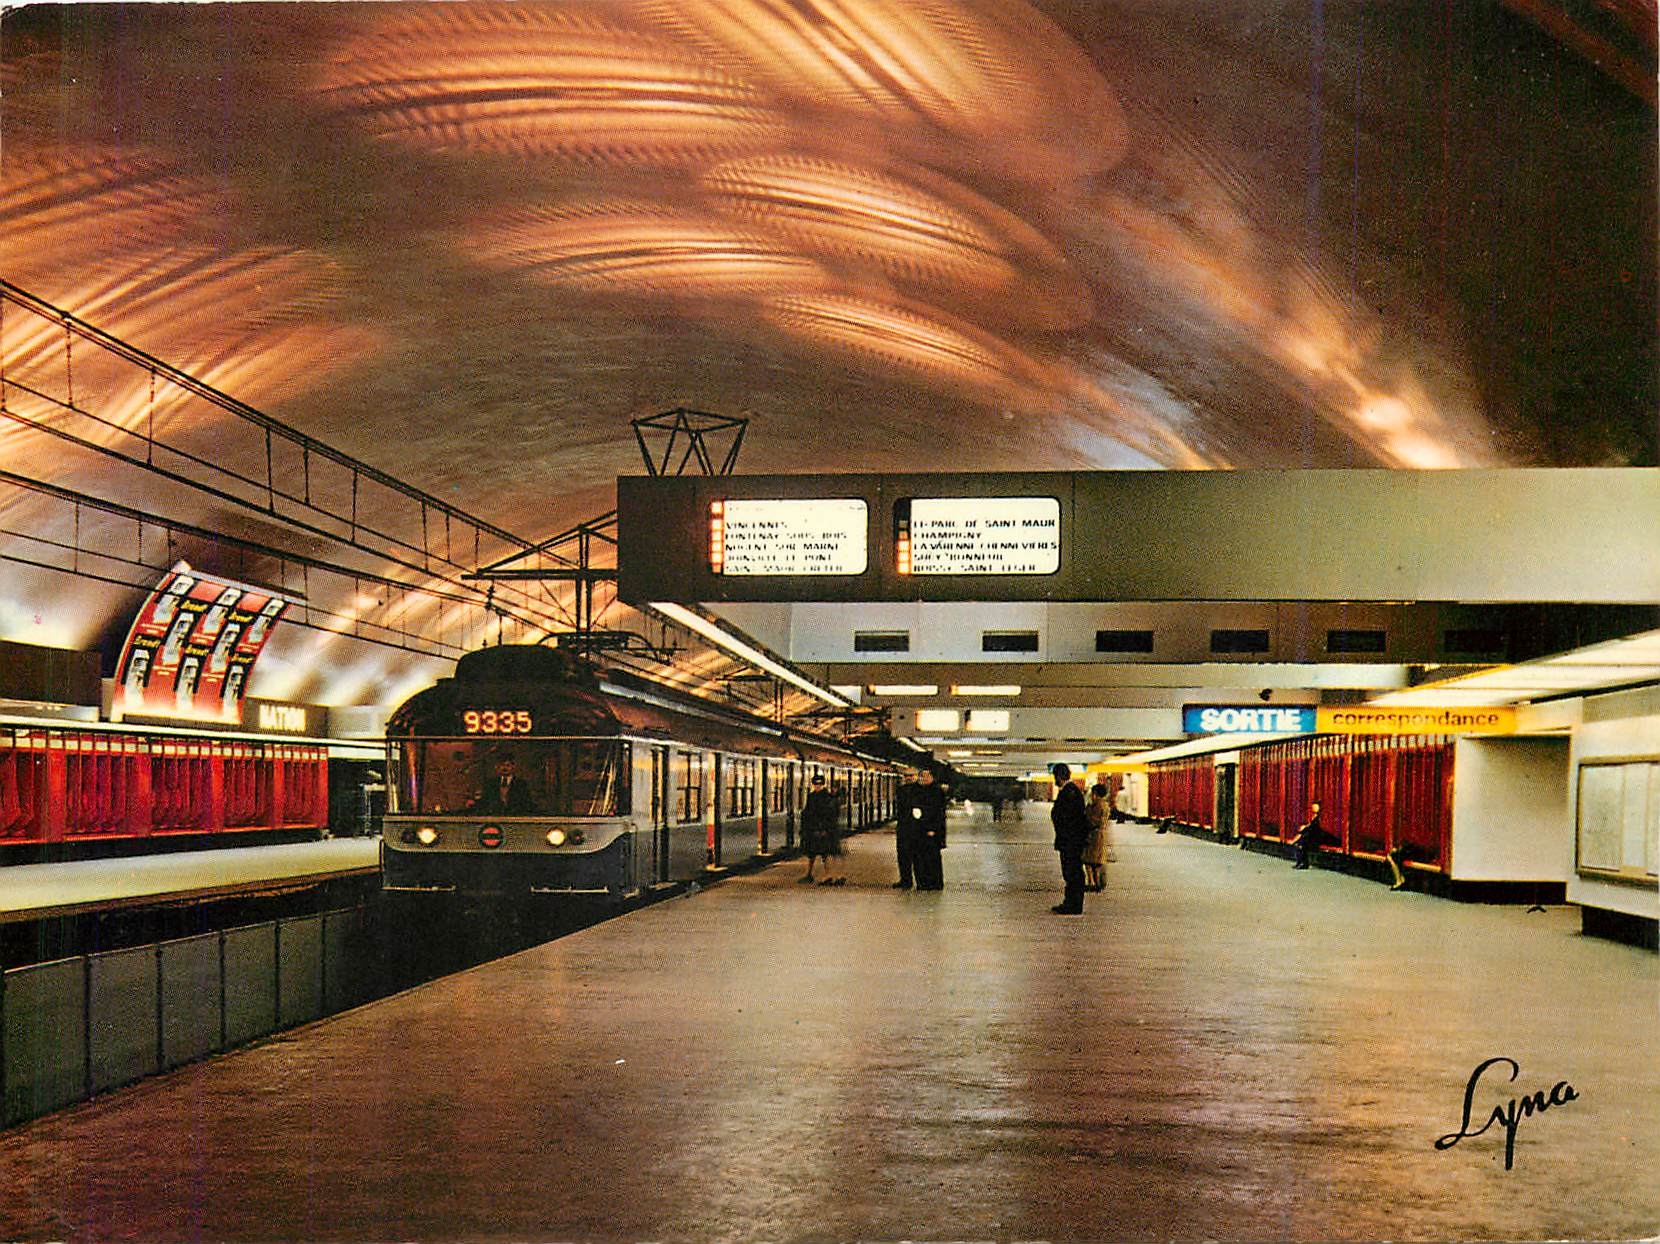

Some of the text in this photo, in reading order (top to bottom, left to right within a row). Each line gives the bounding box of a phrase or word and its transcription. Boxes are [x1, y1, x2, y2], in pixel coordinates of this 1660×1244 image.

[463, 710, 533, 734] 9335
[1200, 707, 1303, 733] SORTIE
[1333, 711, 1500, 731] correspondance
